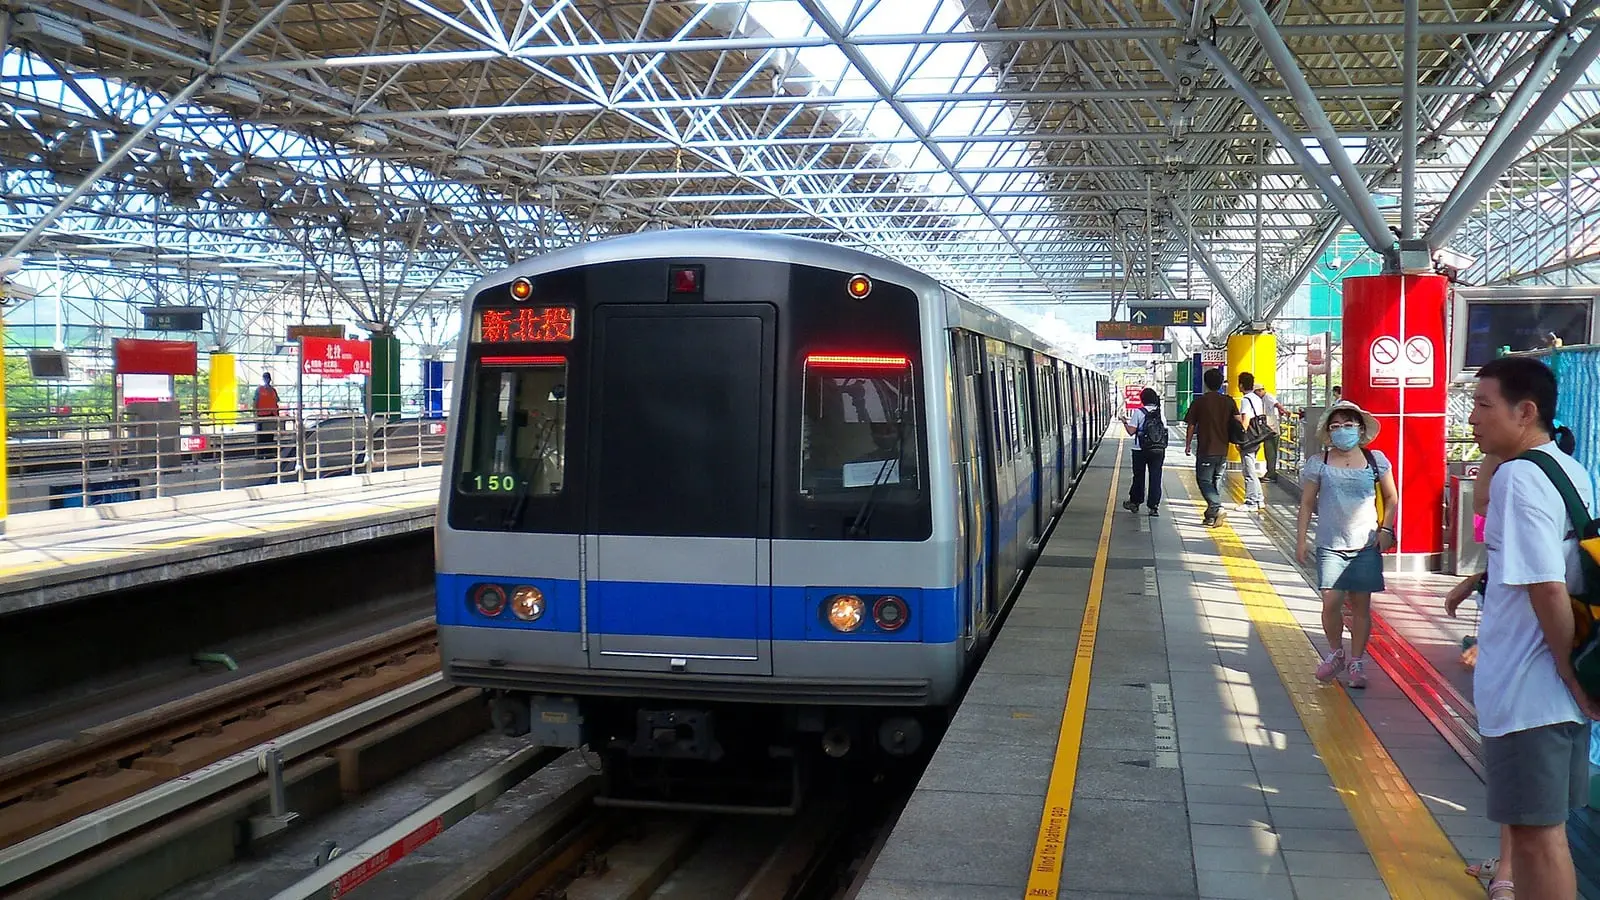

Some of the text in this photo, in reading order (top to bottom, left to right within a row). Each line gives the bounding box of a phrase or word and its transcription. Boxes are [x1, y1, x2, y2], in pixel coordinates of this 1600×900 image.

[1173, 309, 1189, 324] 出口
[482, 308, 571, 342] 新北投
[326, 344, 341, 359] 北投
[474, 475, 514, 491] 150
[1051, 806, 1068, 817] gap
[1044, 818, 1064, 844] platform
[1040, 844, 1058, 855] the
[1036, 855, 1056, 872] Mind
